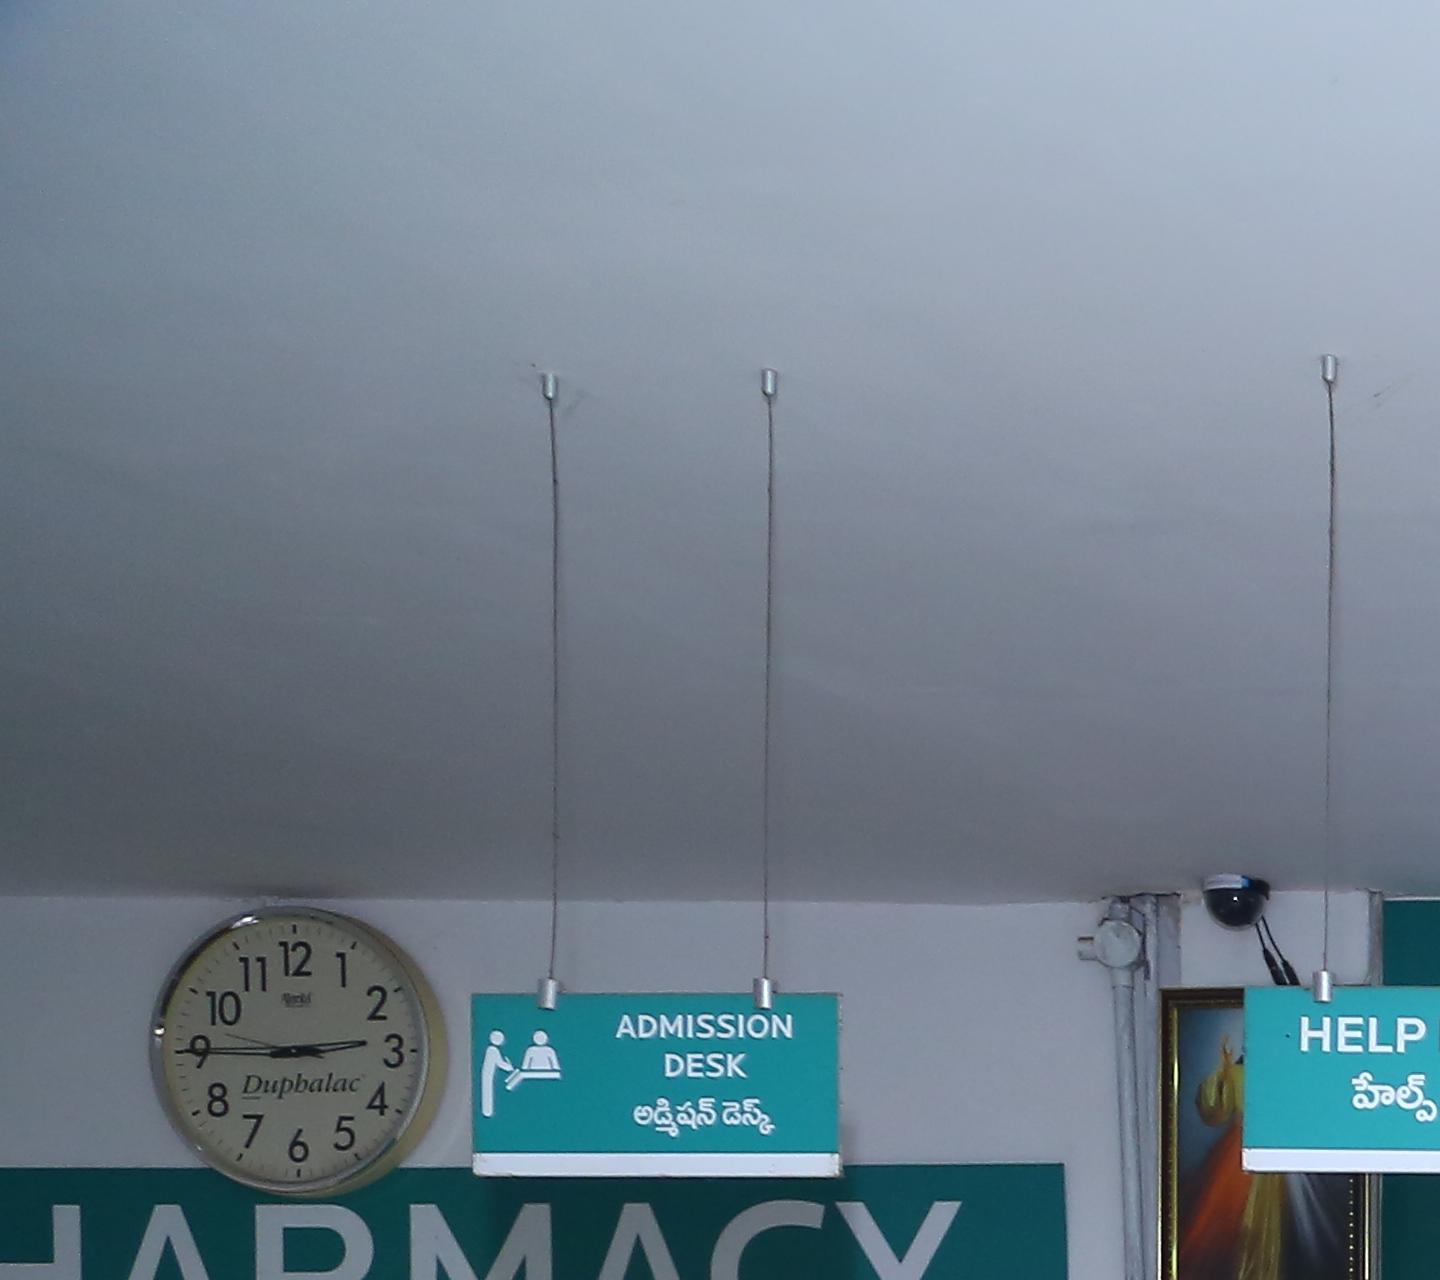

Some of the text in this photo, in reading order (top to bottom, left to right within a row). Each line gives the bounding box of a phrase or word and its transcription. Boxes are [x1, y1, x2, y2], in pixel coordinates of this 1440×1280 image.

[238, 957, 268, 993] 11
[277, 941, 313, 978] 12
[336, 953, 347, 988] 1
[207, 991, 241, 1026] 10
[366, 985, 388, 1021] 2
[616, 1009, 792, 1038] ADMISSION
[1301, 1015, 1426, 1053] HELP
[189, 1034, 211, 1069] 9
[383, 1033, 404, 1068] 3
[665, 1053, 747, 1078] DESK
[207, 1083, 229, 1117] 8
[243, 1073, 361, 1099] Duphalac
[366, 1082, 389, 1116] 4
[243, 1115, 264, 1149] 7
[288, 1129, 309, 1163] 6
[334, 1116, 355, 1151] 5
